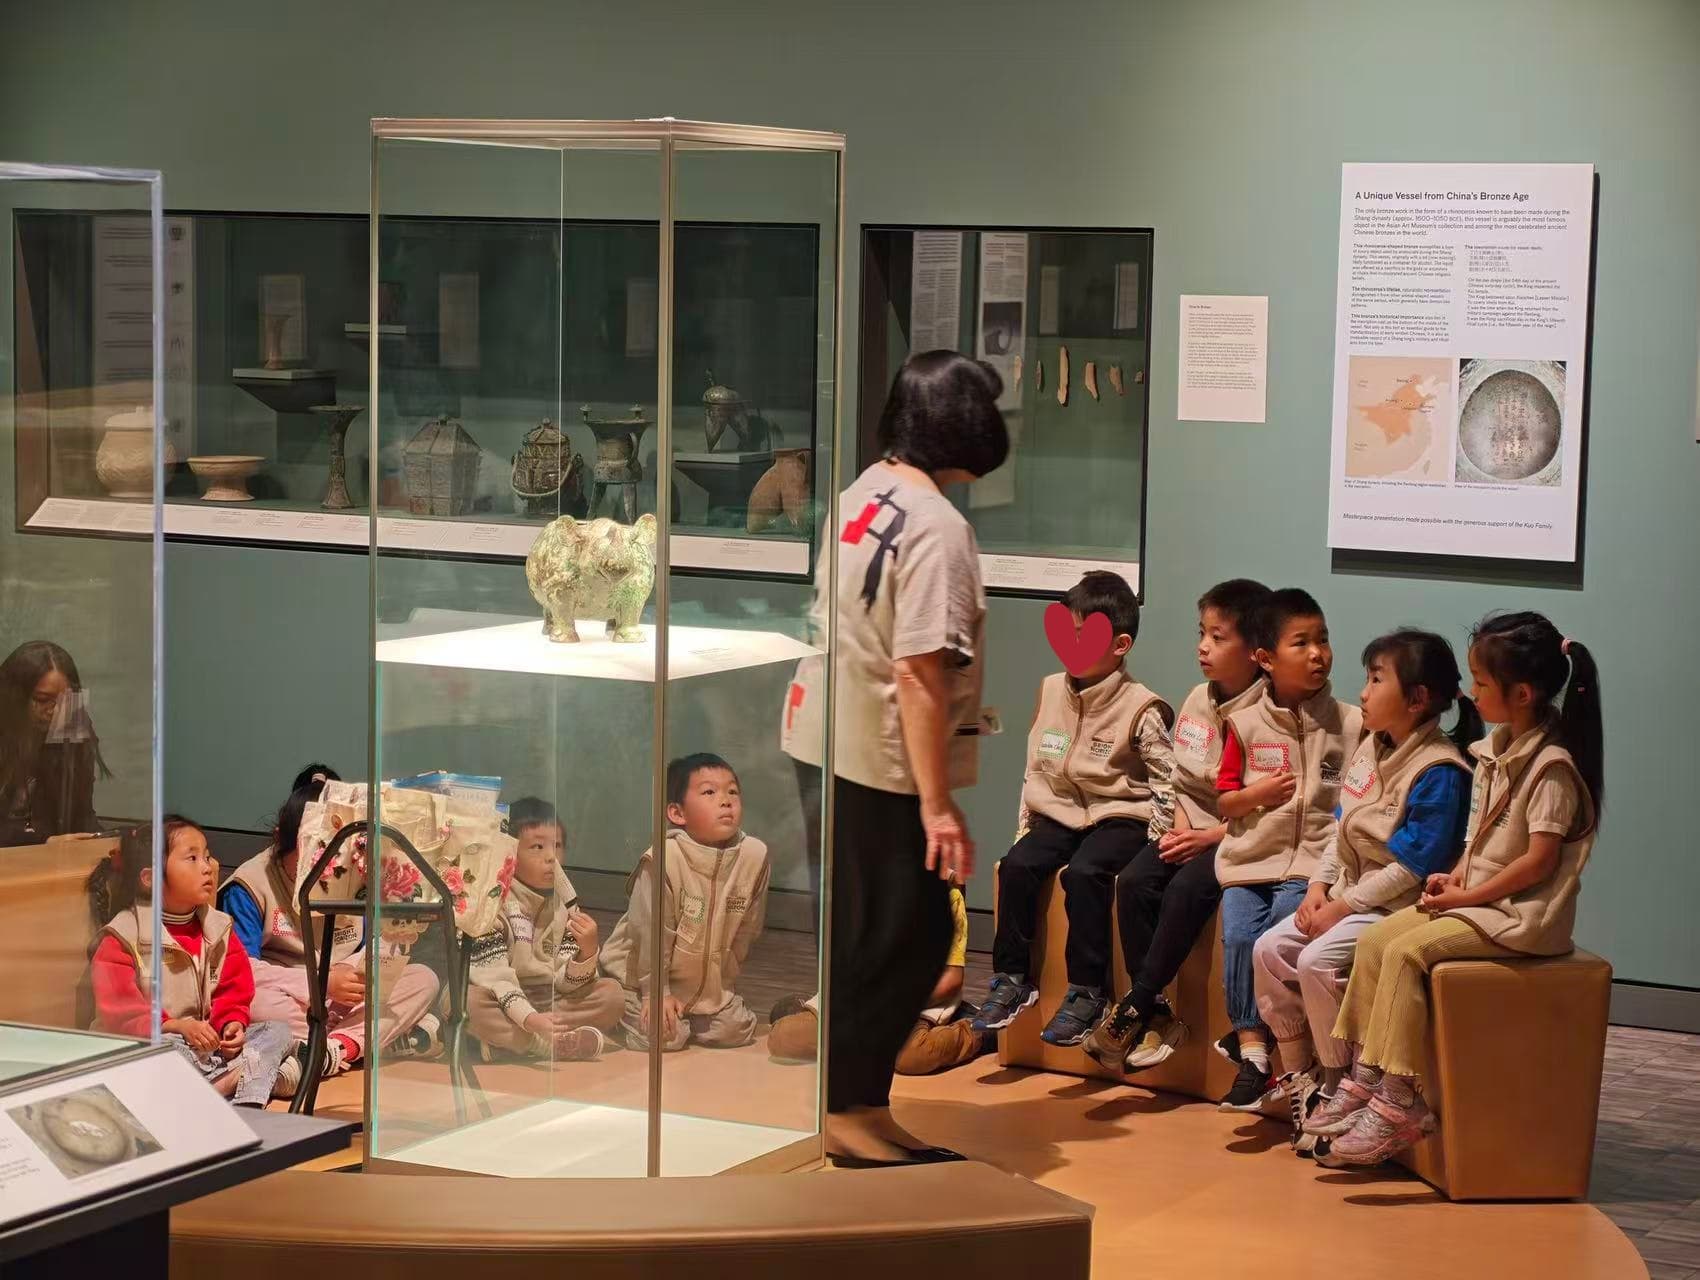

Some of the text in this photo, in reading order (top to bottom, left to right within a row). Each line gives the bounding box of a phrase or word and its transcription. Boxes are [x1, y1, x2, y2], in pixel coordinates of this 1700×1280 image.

[1355, 191, 1529, 202] A Unique Vessel from China's Bronze Age
